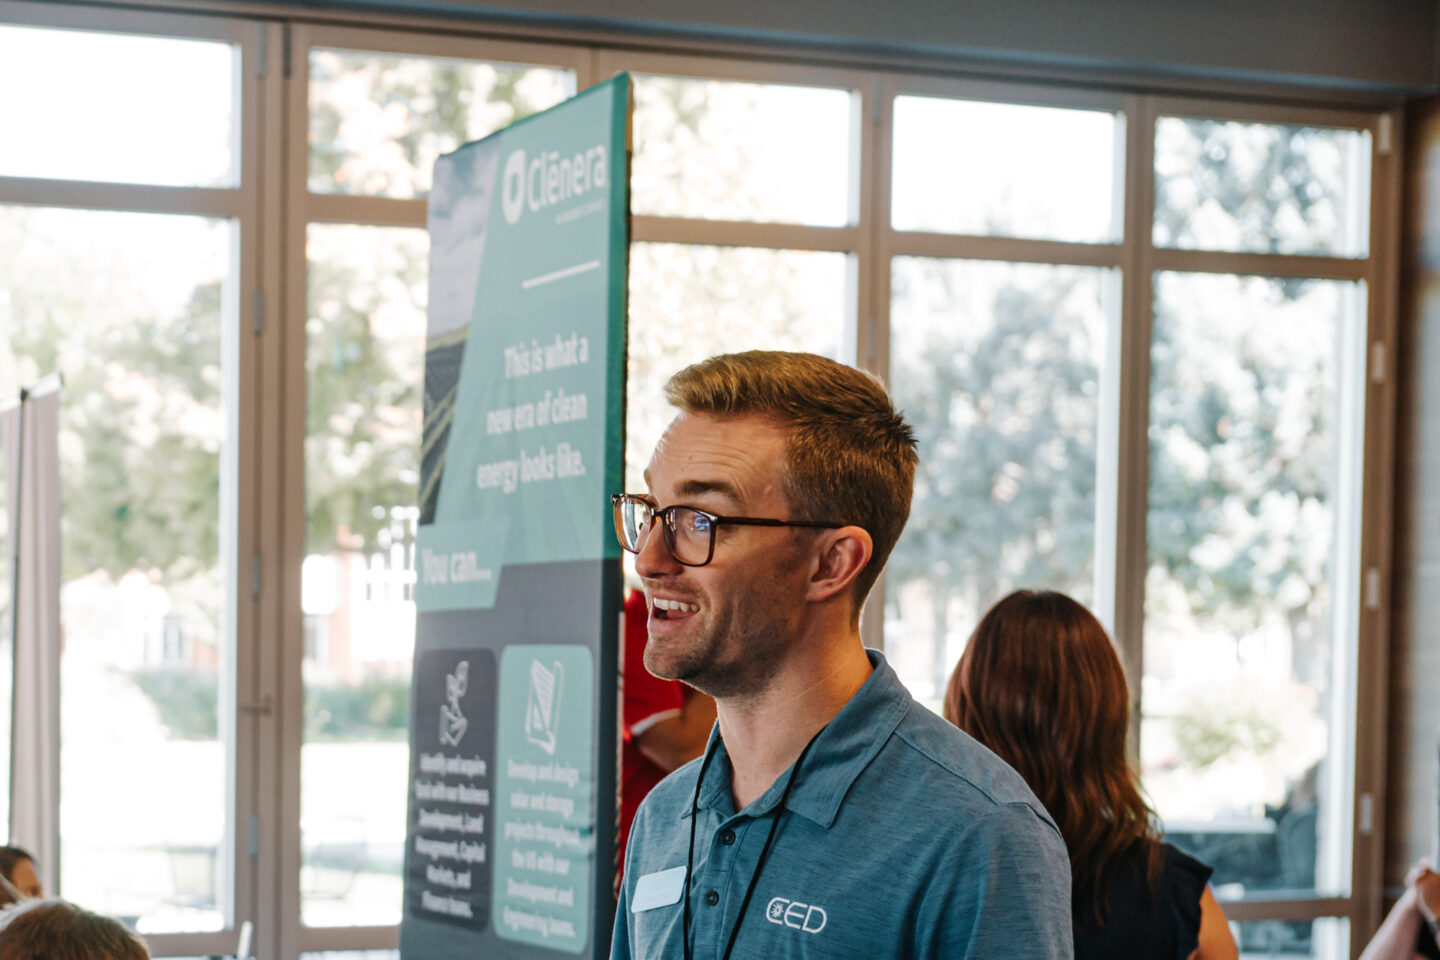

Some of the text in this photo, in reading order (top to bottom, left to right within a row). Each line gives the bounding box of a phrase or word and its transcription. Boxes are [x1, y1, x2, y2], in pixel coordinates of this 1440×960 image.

[527, 144, 606, 213] Clēnera
[504, 332, 588, 379] This is what a
[486, 387, 588, 436] new era of clean
[476, 459, 520, 494] energy
[520, 447, 555, 484] looks
[422, 547, 448, 584] You
[766, 897, 827, 934] CED
